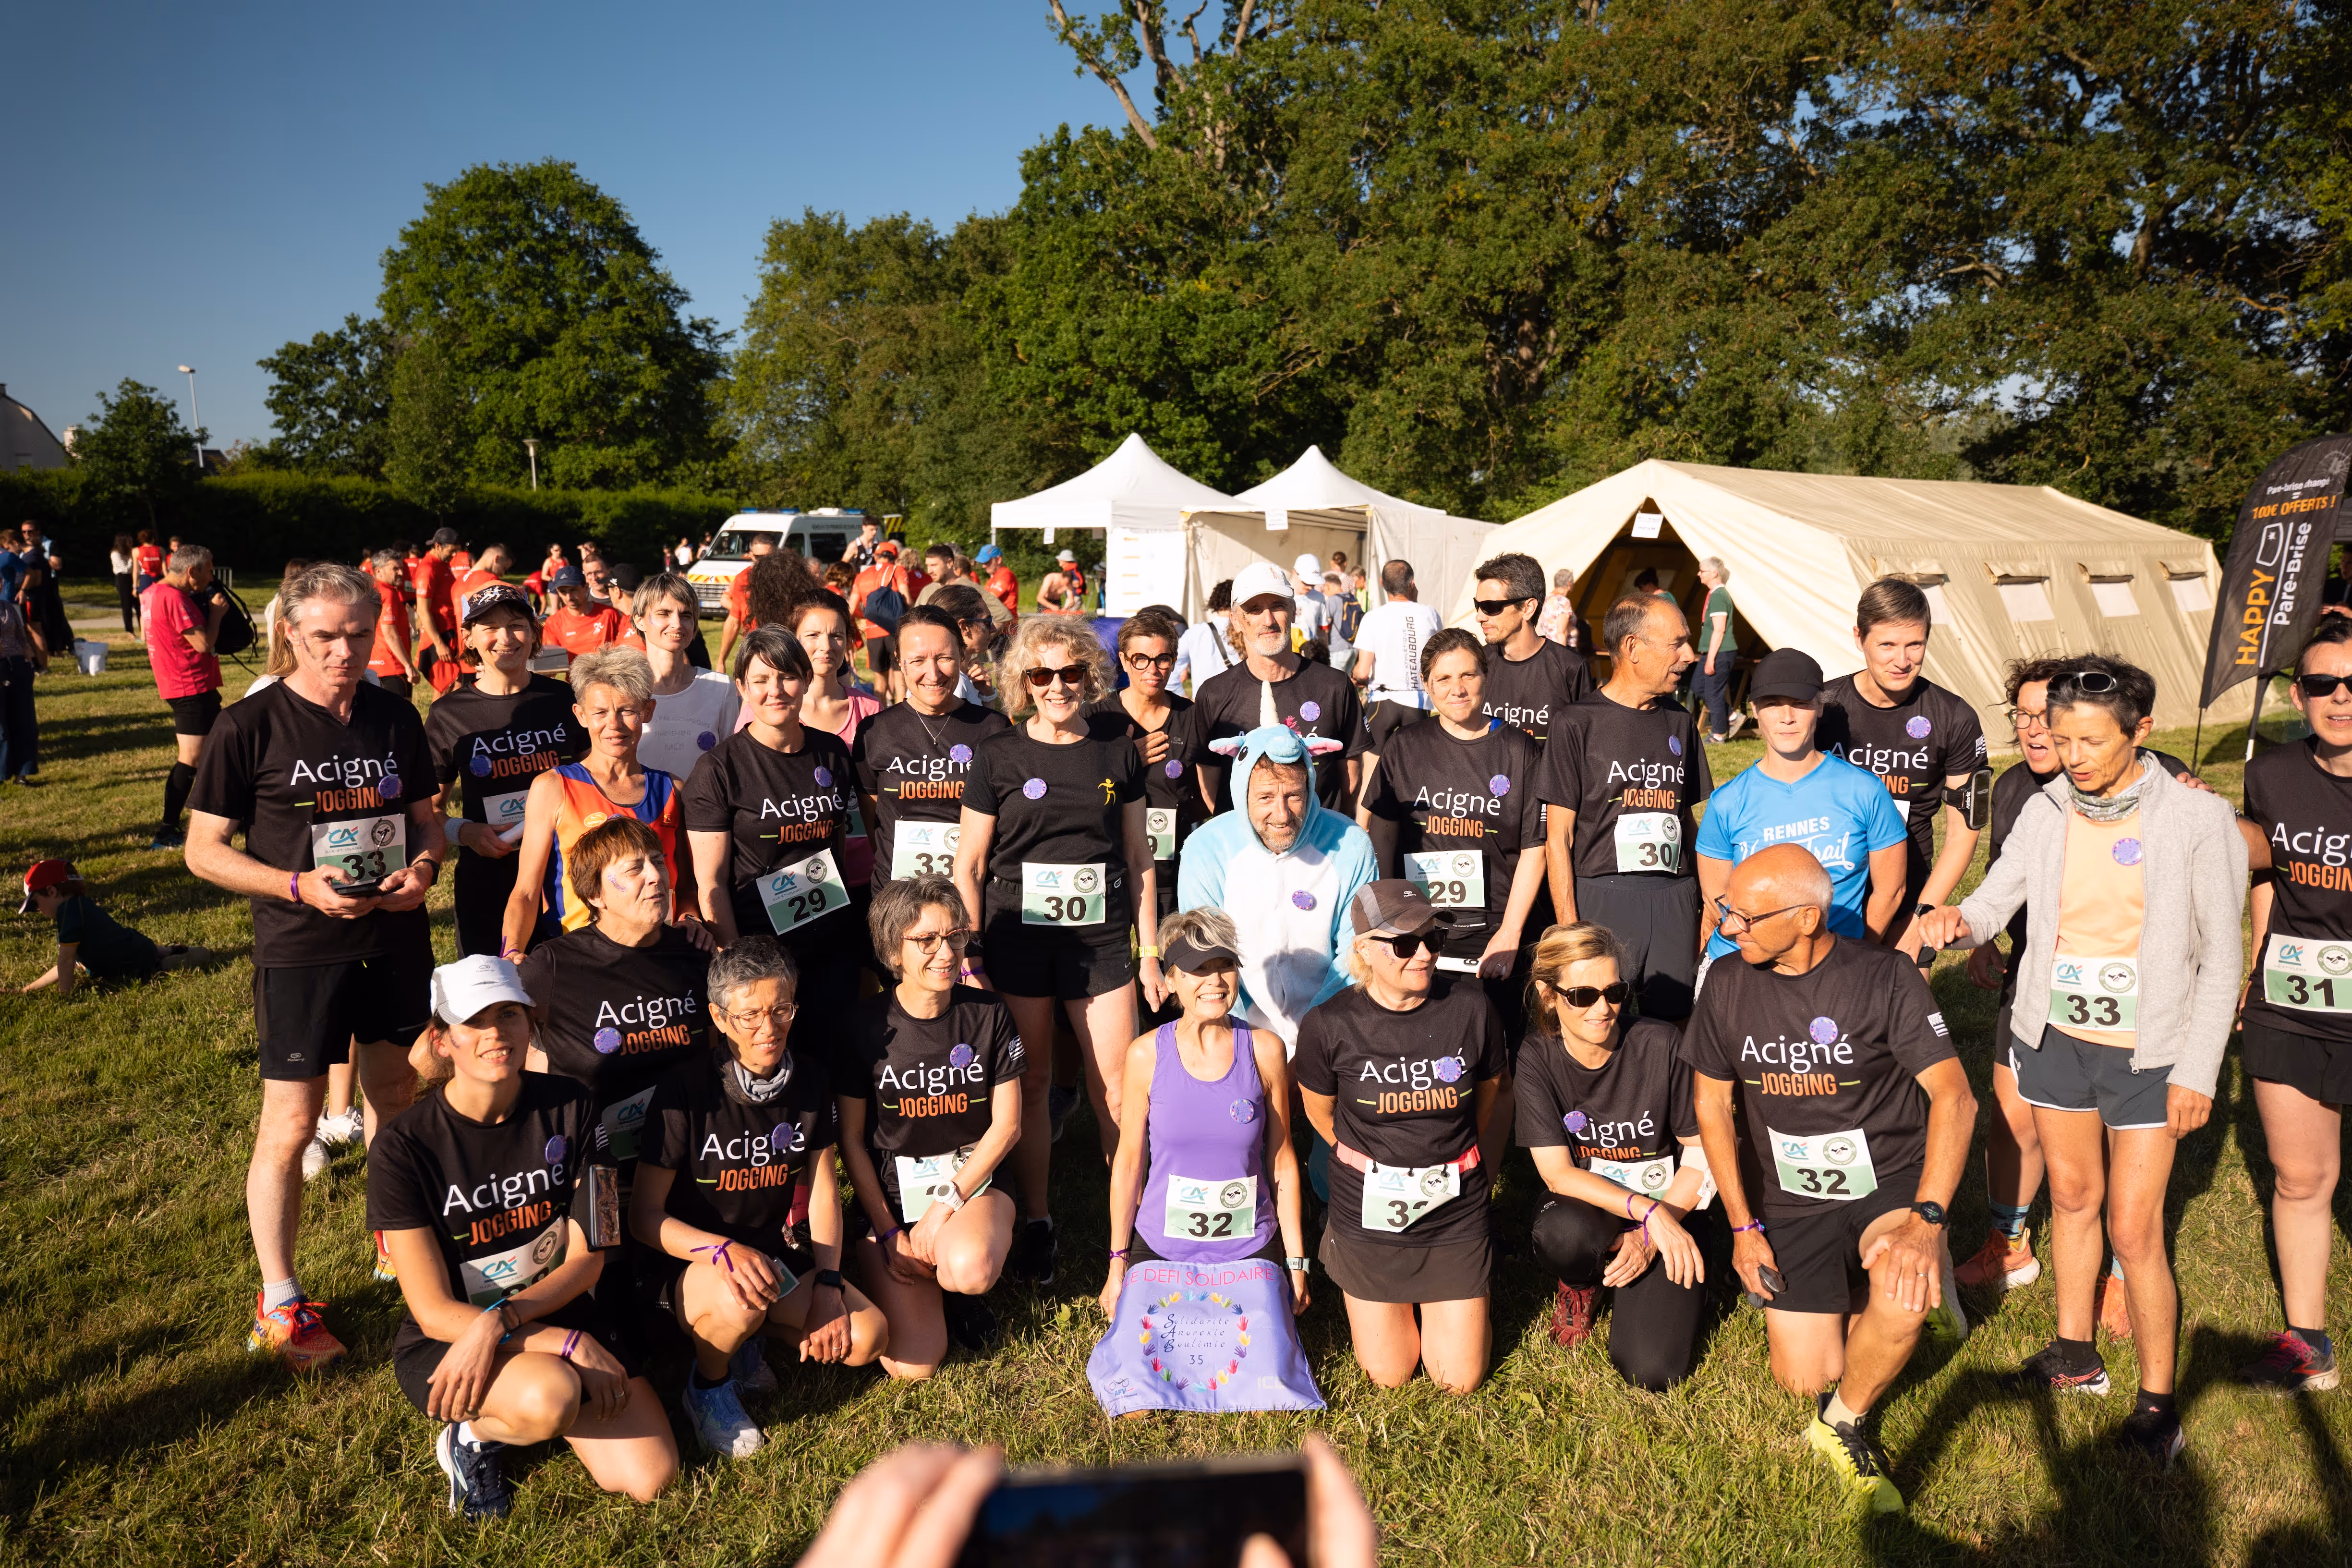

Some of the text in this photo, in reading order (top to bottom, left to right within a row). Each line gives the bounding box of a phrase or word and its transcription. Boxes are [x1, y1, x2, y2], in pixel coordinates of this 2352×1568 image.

[2253, 503, 2279, 519] 100€
[2280, 496, 2328, 515] OFFERTS
[2273, 522, 2312, 625] Pare-Brise
[2235, 569, 2275, 665] HAPPY
[1482, 701, 1549, 728] Acigné
[472, 723, 566, 754] Acigné
[291, 753, 398, 788] Acigné
[492, 750, 559, 778] JOGGING
[1830, 742, 1928, 773] Acigné
[1607, 758, 1685, 790] Acigné
[899, 781, 965, 799] JOGGING
[1414, 786, 1501, 816] Acigné
[1622, 789, 1675, 810] JOGGING
[760, 787, 844, 822] Acigné
[777, 819, 834, 844] JOGGING
[1426, 815, 1483, 838] JOGGING
[1763, 816, 1830, 842] RENNES
[1147, 835, 1158, 855] 9
[1639, 842, 1672, 867] 30
[2272, 822, 2352, 867] Acig
[342, 851, 387, 882] 33
[914, 853, 955, 878] 33
[2288, 860, 2352, 892] JOGGIN
[1428, 880, 1466, 903] 29
[788, 888, 826, 924] 29
[1043, 896, 1086, 922] 30
[2286, 975, 2335, 1007] 31
[595, 989, 697, 1029] Acigné
[2067, 995, 2121, 1026] 33
[1741, 1034, 1853, 1073] Acigné
[879, 1055, 983, 1096] Acigné
[1761, 1072, 1837, 1096] JOGGING
[898, 1093, 967, 1118] JOGGING
[1376, 1086, 1458, 1115] JOGGING
[1576, 1110, 1655, 1147] cigné
[716, 1164, 788, 1191] JOGGING
[1797, 1168, 1850, 1195] 32
[469, 1201, 551, 1246] JOGGING
[1188, 1212, 1233, 1237] 32
[1125, 1267, 1274, 1288] LE DEFI SOLIDAIRE
[1161, 1325, 1225, 1338] Anorexie
[1164, 1338, 1225, 1352] Boulimie
[1189, 1355, 1203, 1365] 35
[1115, 1388, 1127, 1397] AFV
